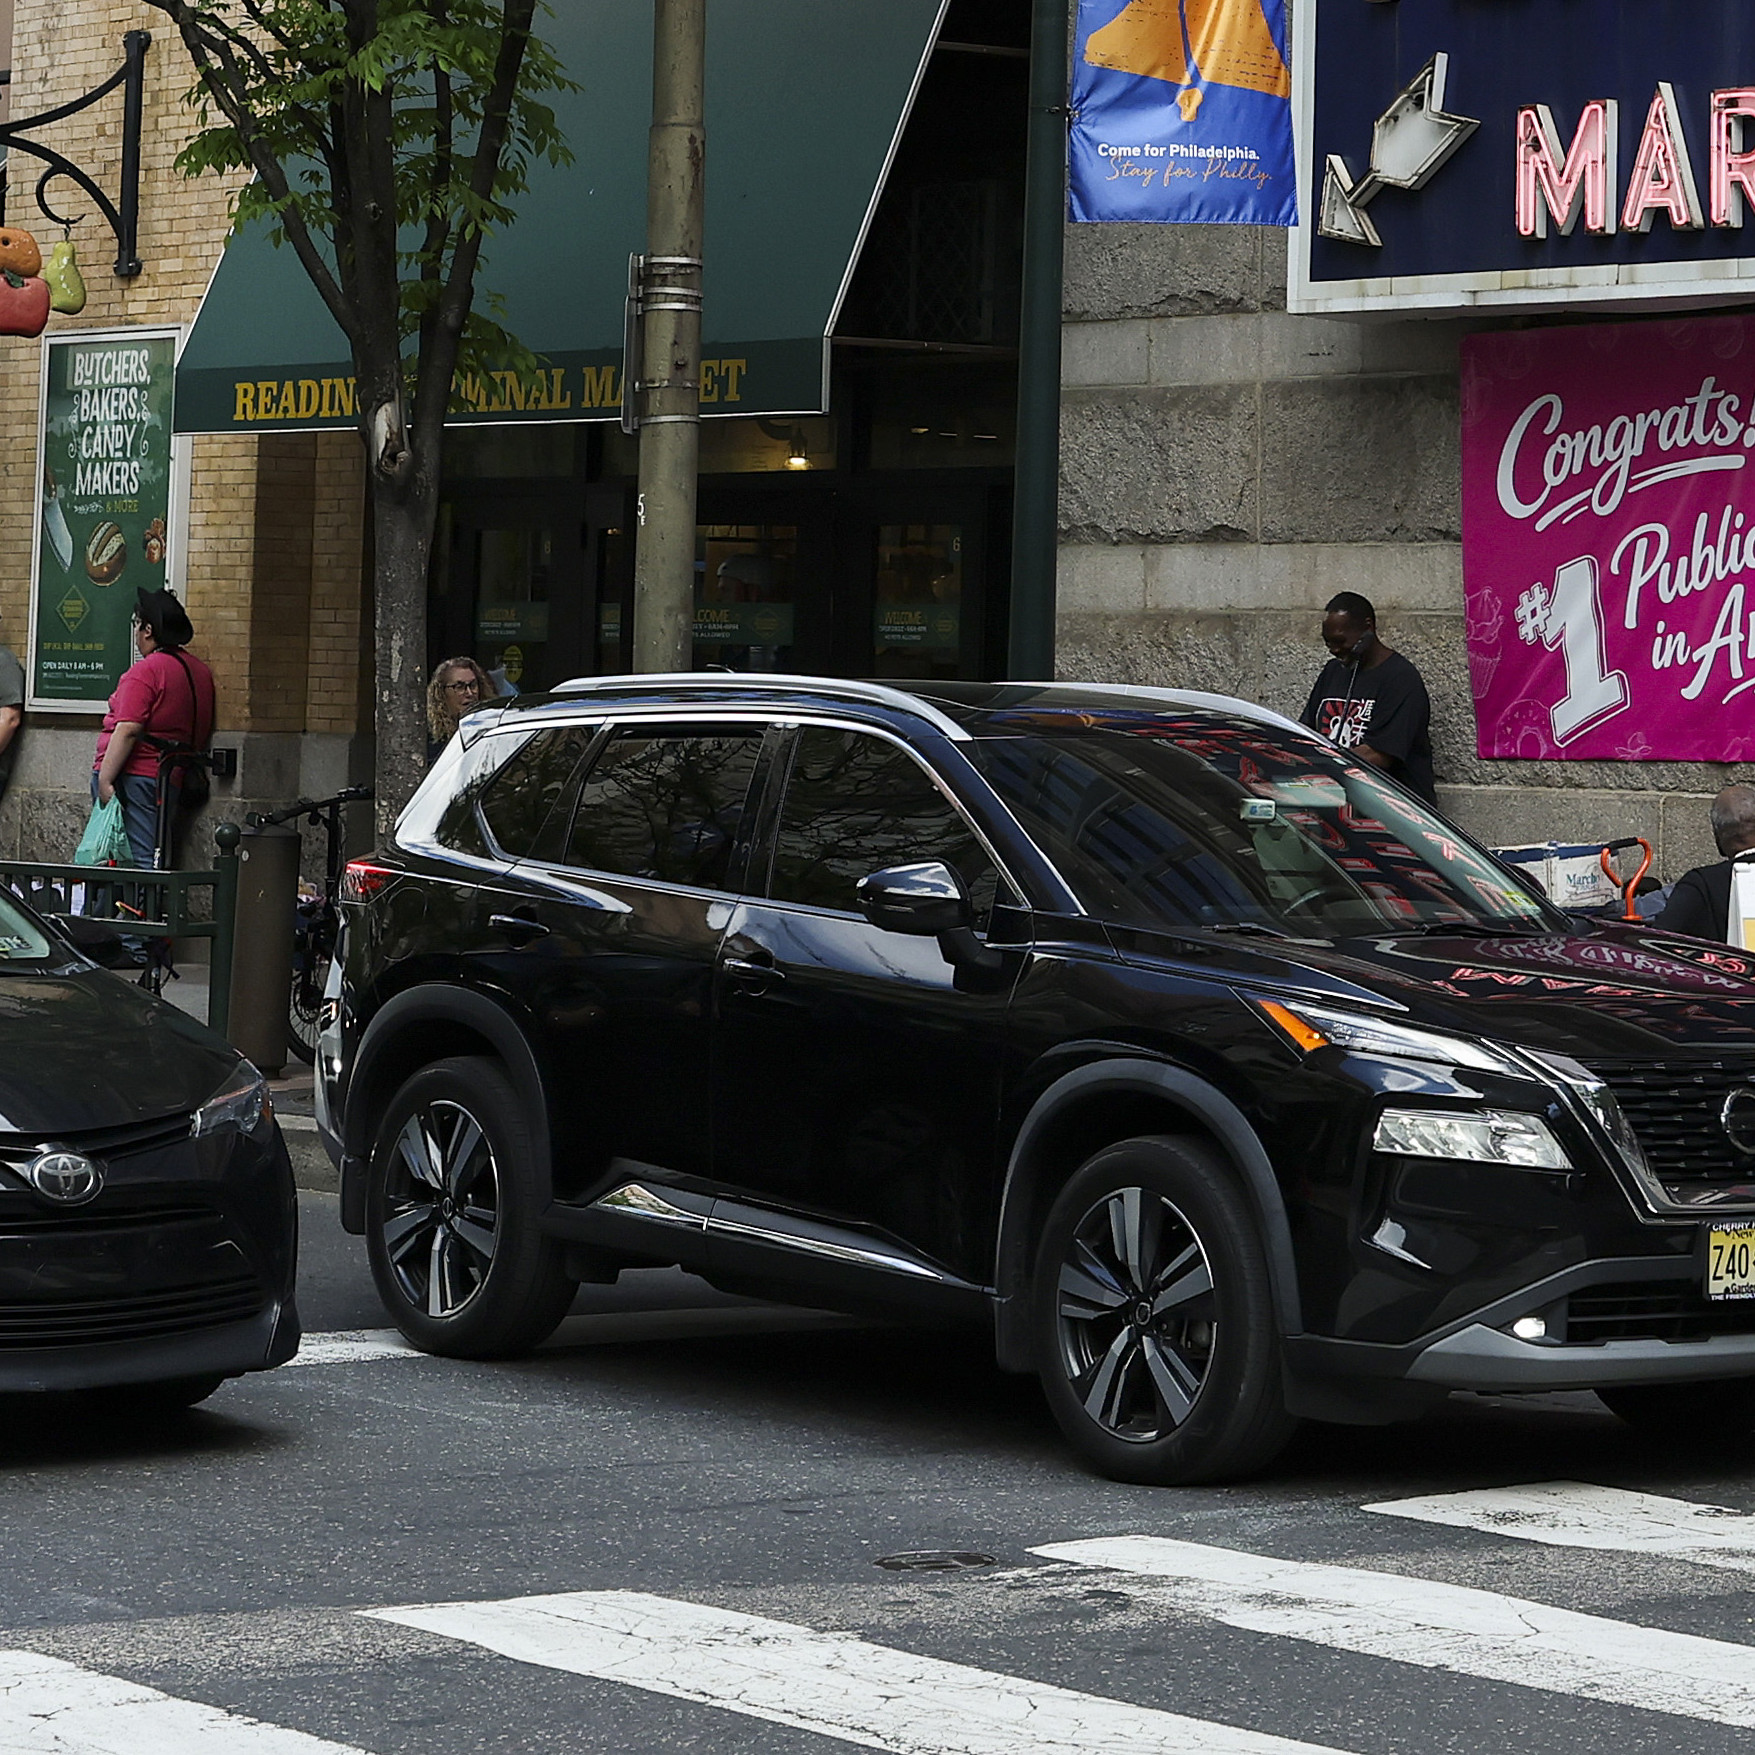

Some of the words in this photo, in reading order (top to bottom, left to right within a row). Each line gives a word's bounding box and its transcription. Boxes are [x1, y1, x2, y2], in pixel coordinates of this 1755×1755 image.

[1097, 143, 1141, 157] Come
[1144, 143, 1167, 157] for
[1169, 144, 1260, 161] Philadelphia.
[1105, 155, 1158, 187] Stay
[1163, 160, 1198, 187] for
[1202, 157, 1273, 190] Philly.
[74, 348, 151, 387] BUTCHERS,
[80, 386, 141, 423] BAKERS,
[233, 376, 361, 421] READIN
[82, 424, 137, 459] CANDY
[76, 461, 139, 496] MAKERS
[113, 499, 139, 513] MORE
[1515, 554, 1631, 748] #1
[1651, 620, 1691, 669] in
[1712, 1221, 1750, 1232] CHERRY
[1732, 1229, 1754, 1240] New
[1712, 1243, 1749, 1281] Z40
